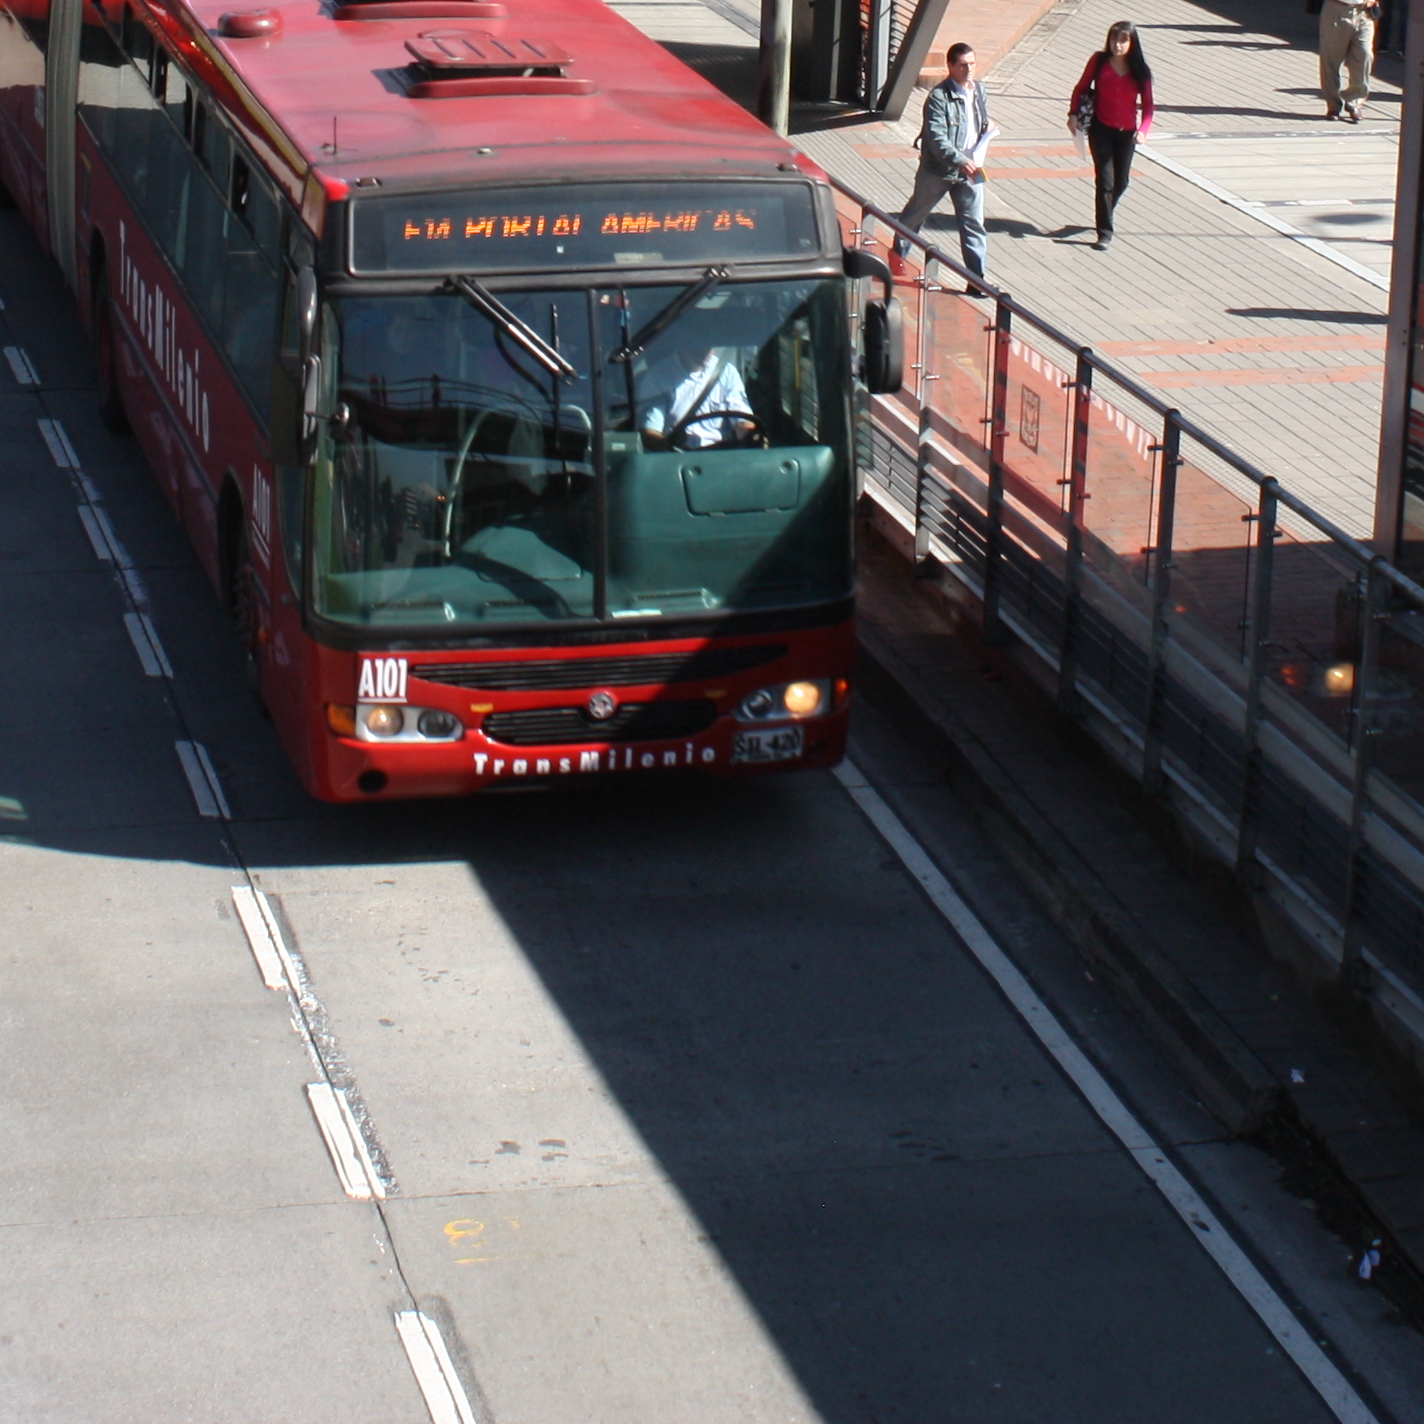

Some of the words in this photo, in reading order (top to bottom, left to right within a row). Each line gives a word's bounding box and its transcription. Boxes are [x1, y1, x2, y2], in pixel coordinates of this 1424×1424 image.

[119, 218, 210, 454] TransMilenio
[358, 658, 408, 697] A101
[473, 742, 716, 775] TransMilenio
